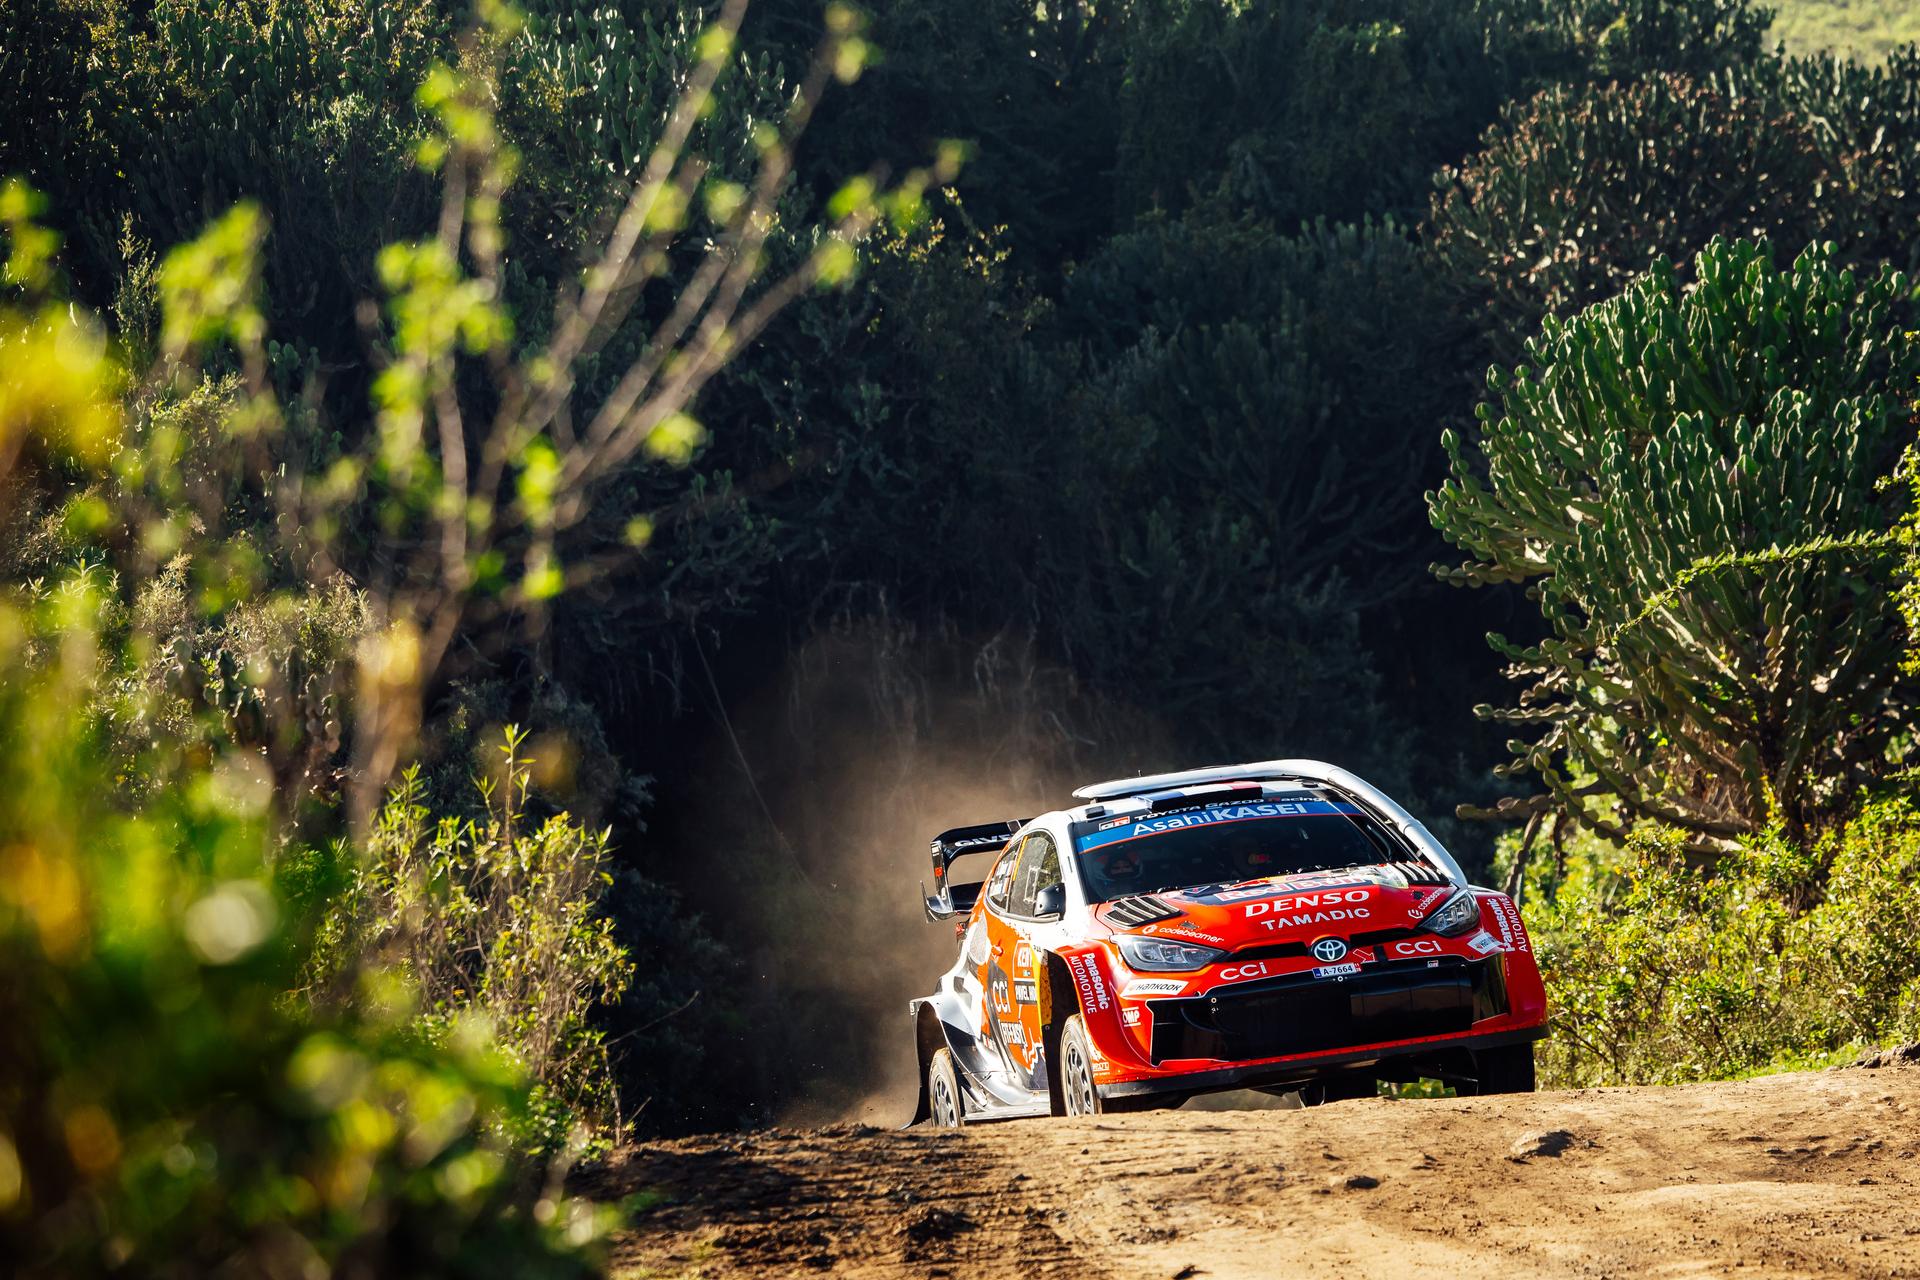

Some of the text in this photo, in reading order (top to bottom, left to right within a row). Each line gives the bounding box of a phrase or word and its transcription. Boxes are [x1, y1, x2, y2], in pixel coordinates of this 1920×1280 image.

[1134, 804, 1202, 821] TOYOTA
[1213, 882, 1294, 902] Red
[1245, 890, 1370, 918] DENSO
[1260, 908, 1370, 930] TAMADIC
[1486, 898, 1516, 952] Panasonic
[1498, 897, 1529, 953] AUTOMOTIVE
[1159, 927, 1223, 943] codebeamer
[1081, 952, 1109, 1010] Panasonic
[1323, 965, 1353, 976] A-7664
[1068, 955, 1098, 1014] AUTOMOTIVE
[1122, 1009, 1141, 1024] OMP
